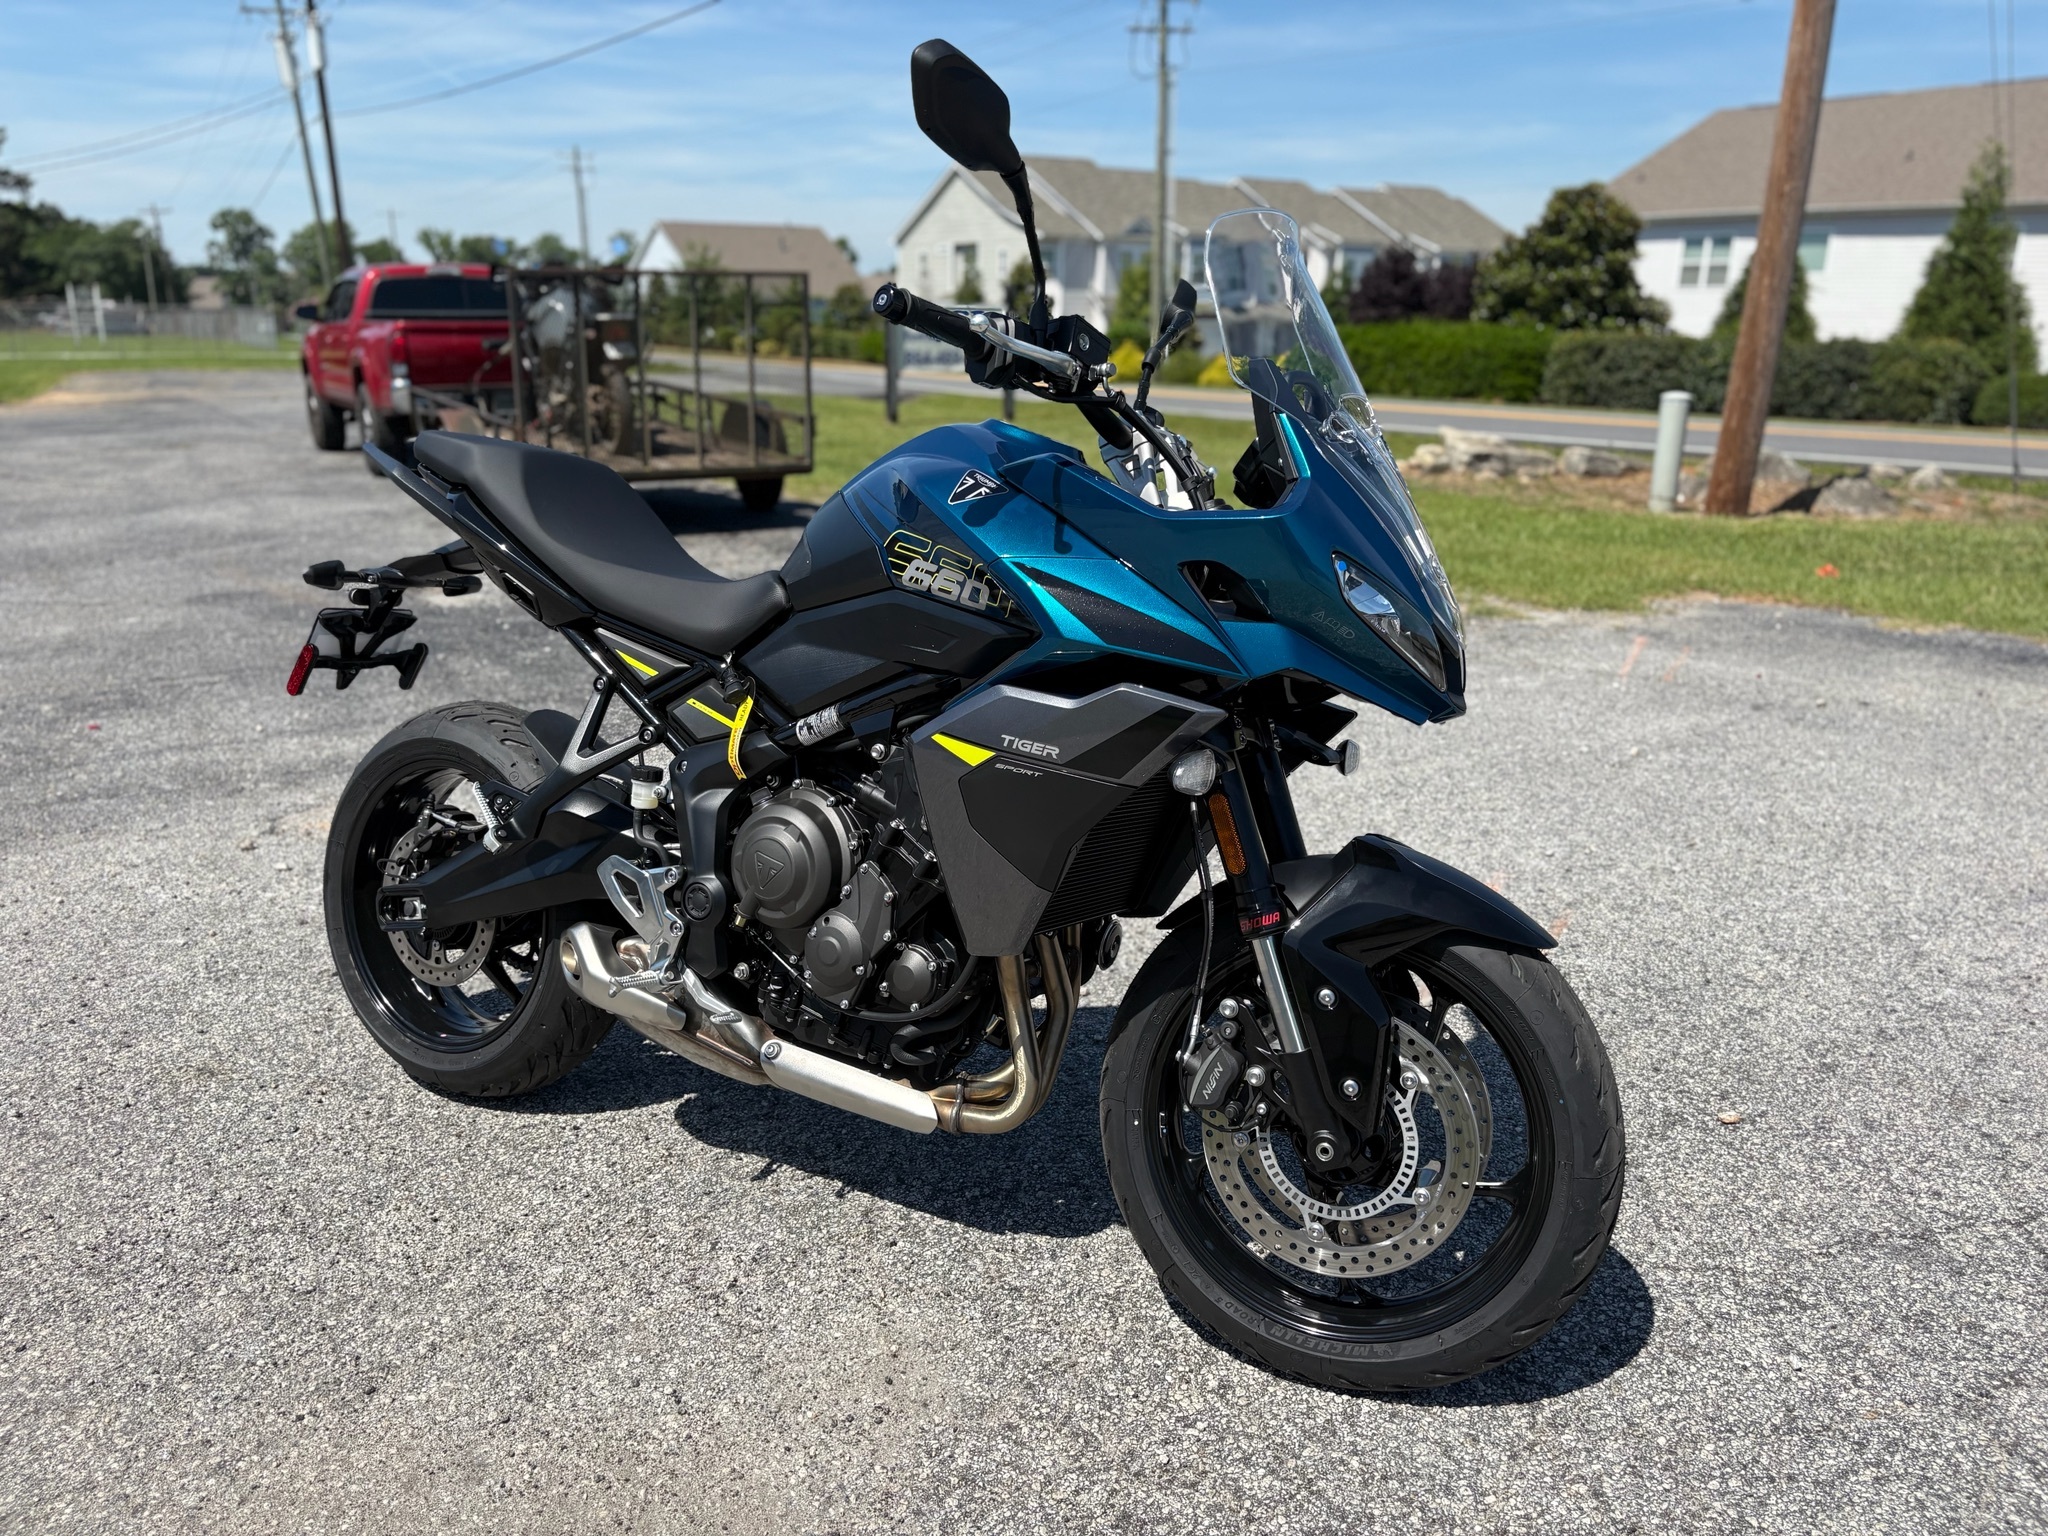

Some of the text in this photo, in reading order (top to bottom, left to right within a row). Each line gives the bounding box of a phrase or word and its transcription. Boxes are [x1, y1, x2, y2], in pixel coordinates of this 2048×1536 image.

[902, 559, 990, 610] 660
[1001, 734, 1060, 759] TIGER
[994, 763, 1044, 777] SPORT
[1240, 911, 1280, 931] SHOWA
[1225, 1301, 1257, 1325] ROAD
[1270, 1325, 1369, 1357] MICHELIN
